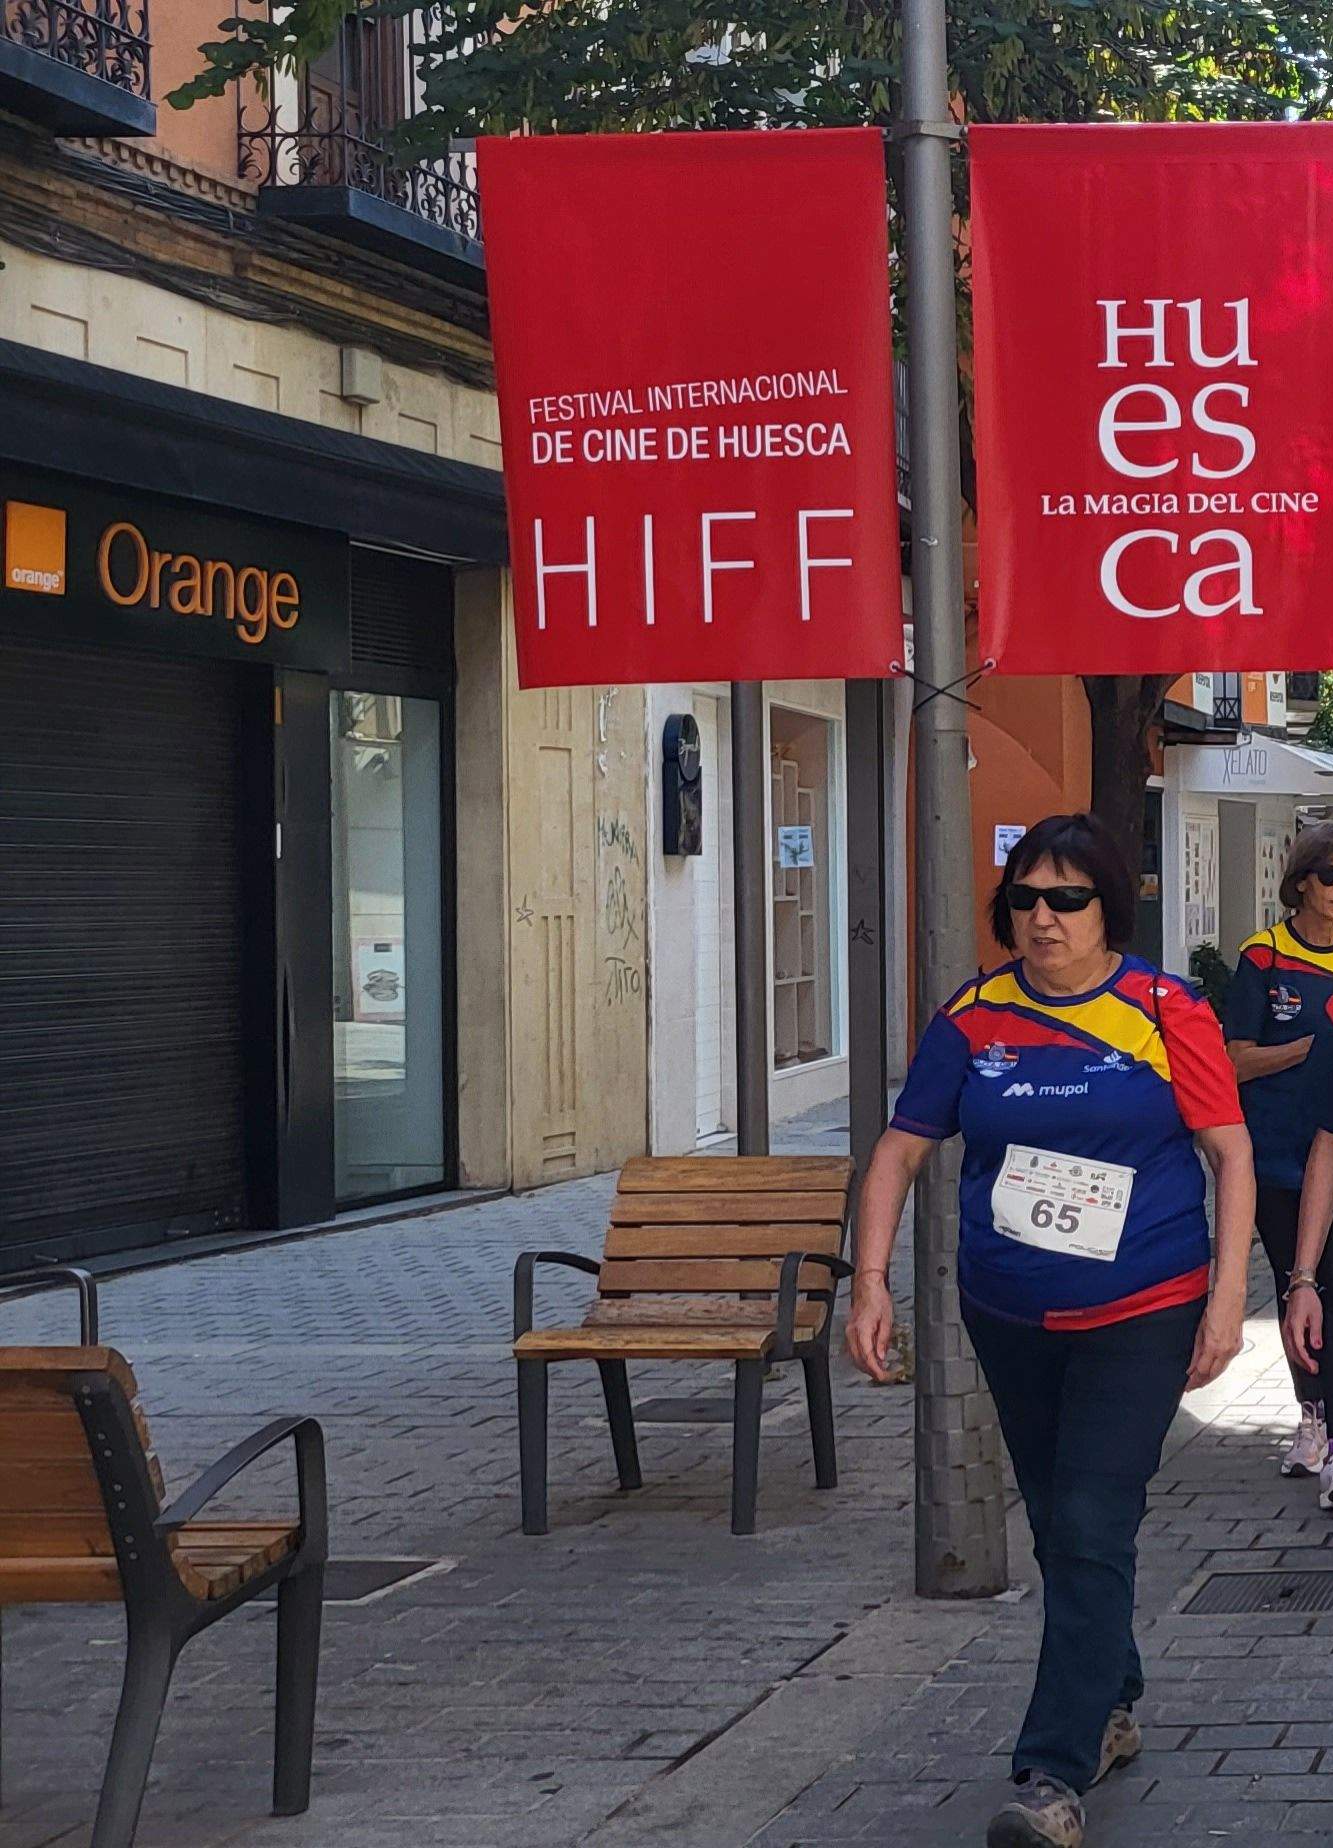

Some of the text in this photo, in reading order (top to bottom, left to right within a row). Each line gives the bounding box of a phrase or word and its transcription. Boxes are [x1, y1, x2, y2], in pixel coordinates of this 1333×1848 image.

[529, 369, 849, 424] FESTIVAL INTERNACIONAL
[531, 421, 852, 465] DE CINE DE HUESCA
[1098, 382, 1257, 480] es
[12, 567, 61, 592] orange
[98, 521, 300, 644] Orange
[535, 508, 855, 630] HIFF
[1100, 529, 1264, 618] ca
[1223, 748, 1267, 784] XELATO
[1038, 1081, 1089, 1098] mupol
[1030, 1199, 1083, 1234] 65
